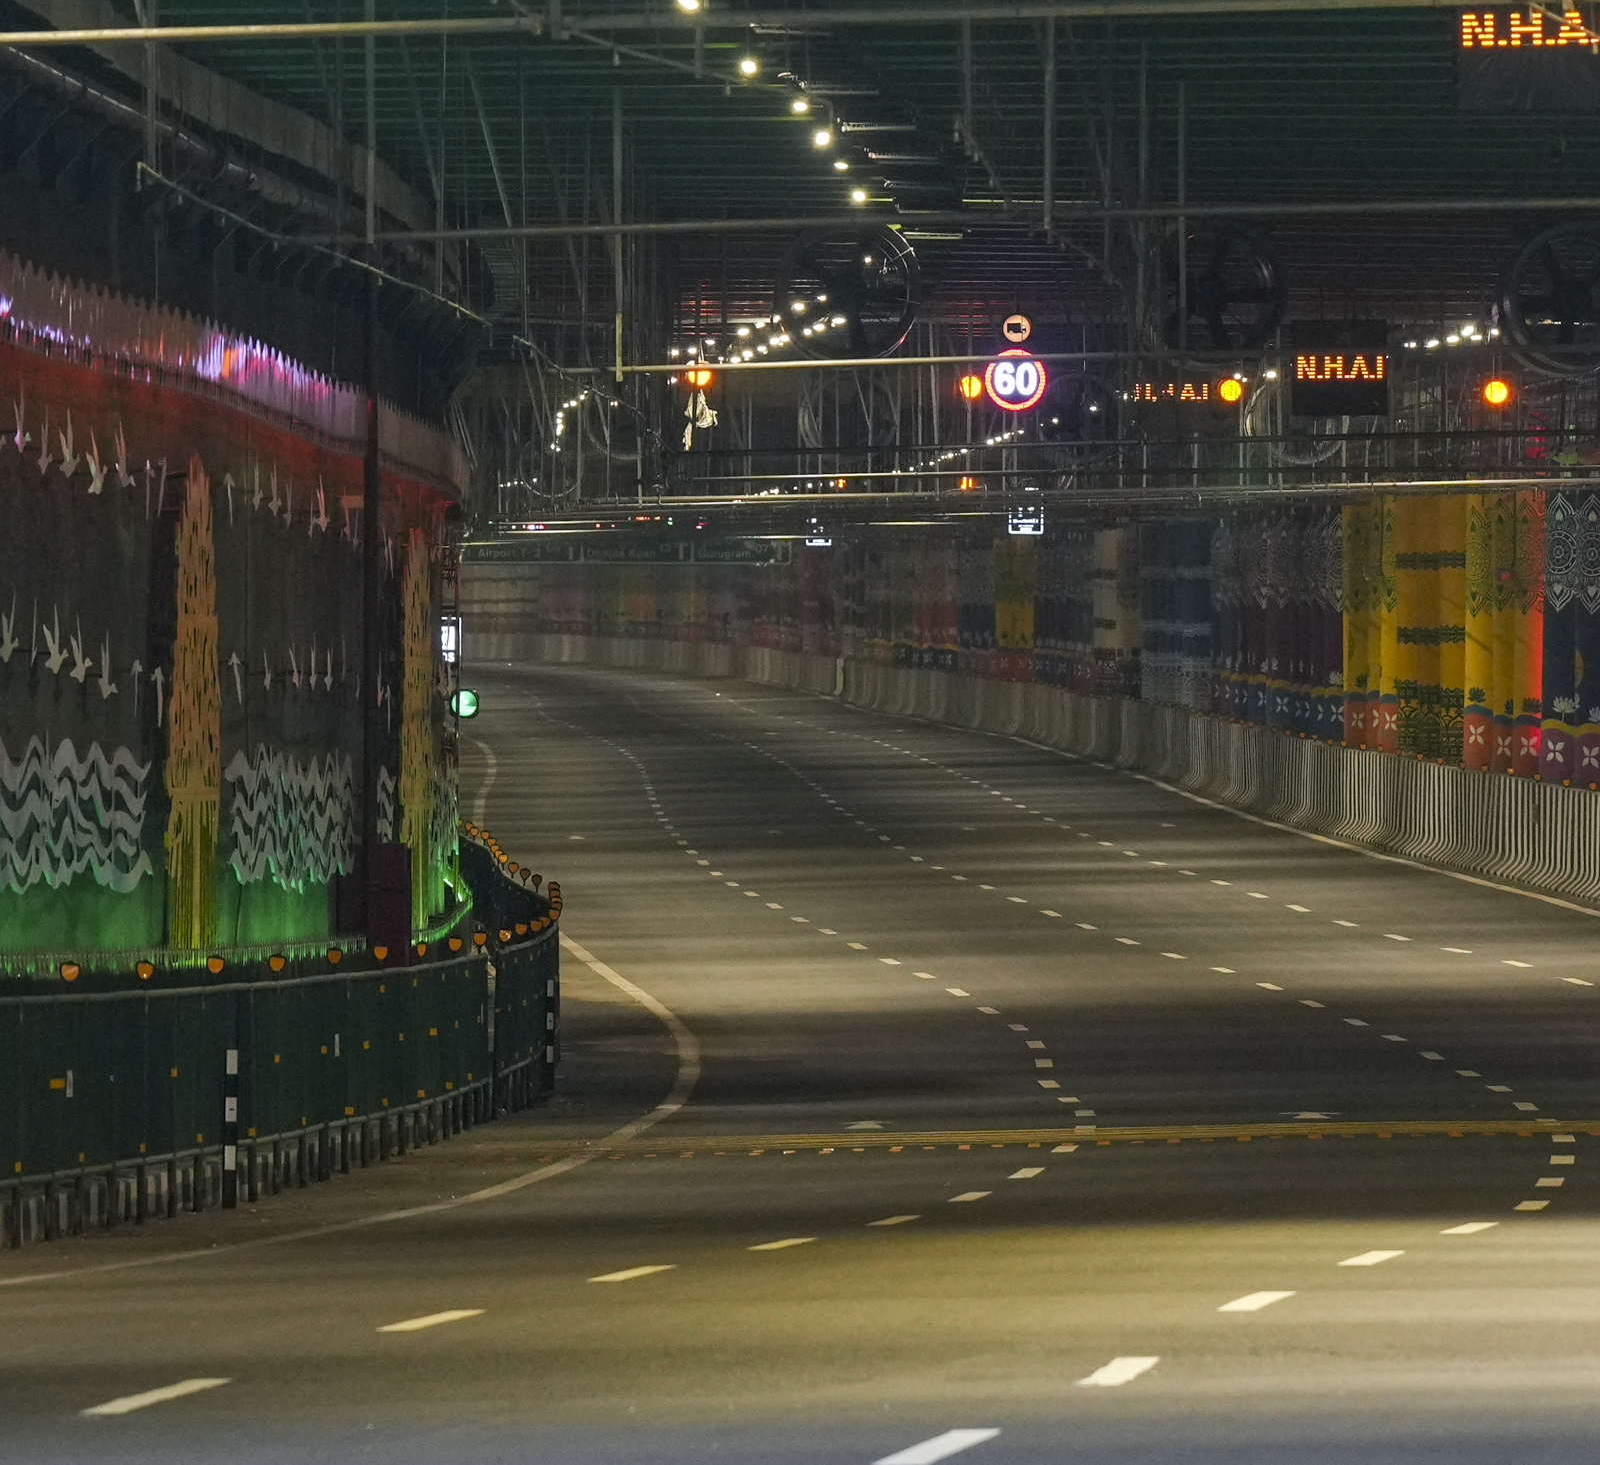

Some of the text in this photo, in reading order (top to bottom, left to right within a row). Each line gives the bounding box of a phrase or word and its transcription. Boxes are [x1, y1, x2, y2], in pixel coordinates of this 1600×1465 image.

[994, 361, 1038, 396] 60
[478, 547, 516, 559] Airport
[628, 547, 656, 558] Kuan
[698, 548, 751, 560] Gurugram
[755, 543, 769, 554] 07
